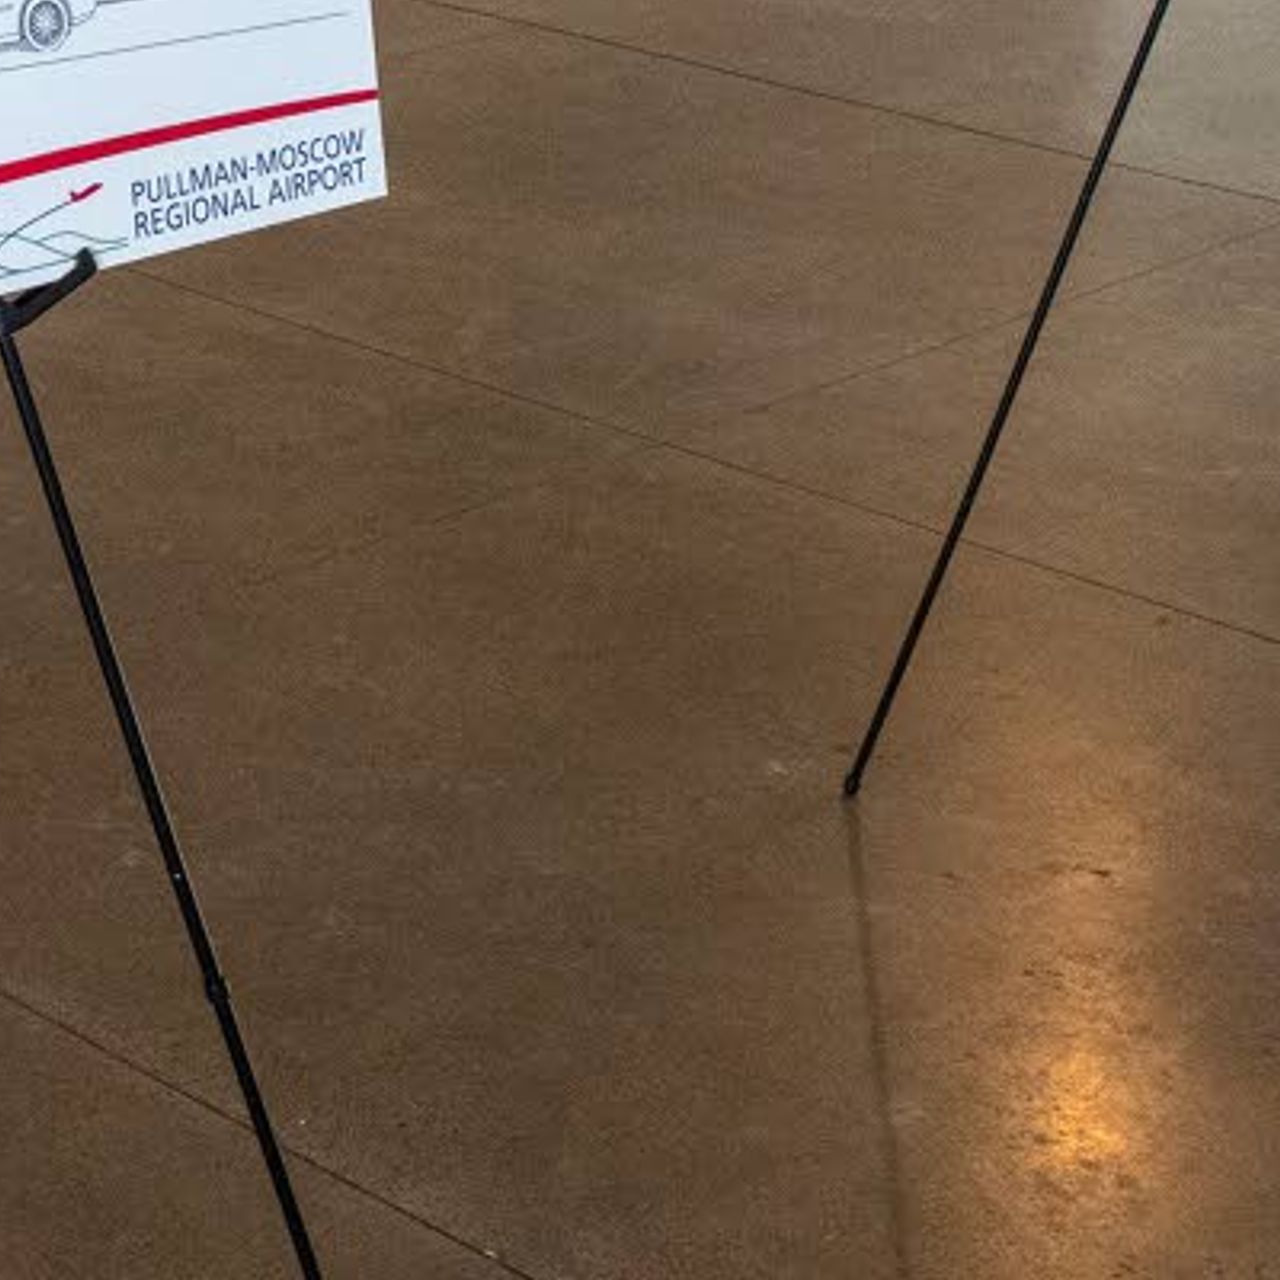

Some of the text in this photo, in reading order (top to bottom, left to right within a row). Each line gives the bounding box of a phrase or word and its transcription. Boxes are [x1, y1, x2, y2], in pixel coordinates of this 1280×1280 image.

[131, 129, 365, 205] PULLMAN-MOSCOW
[133, 157, 367, 238] REGIONAL AIRPORT
